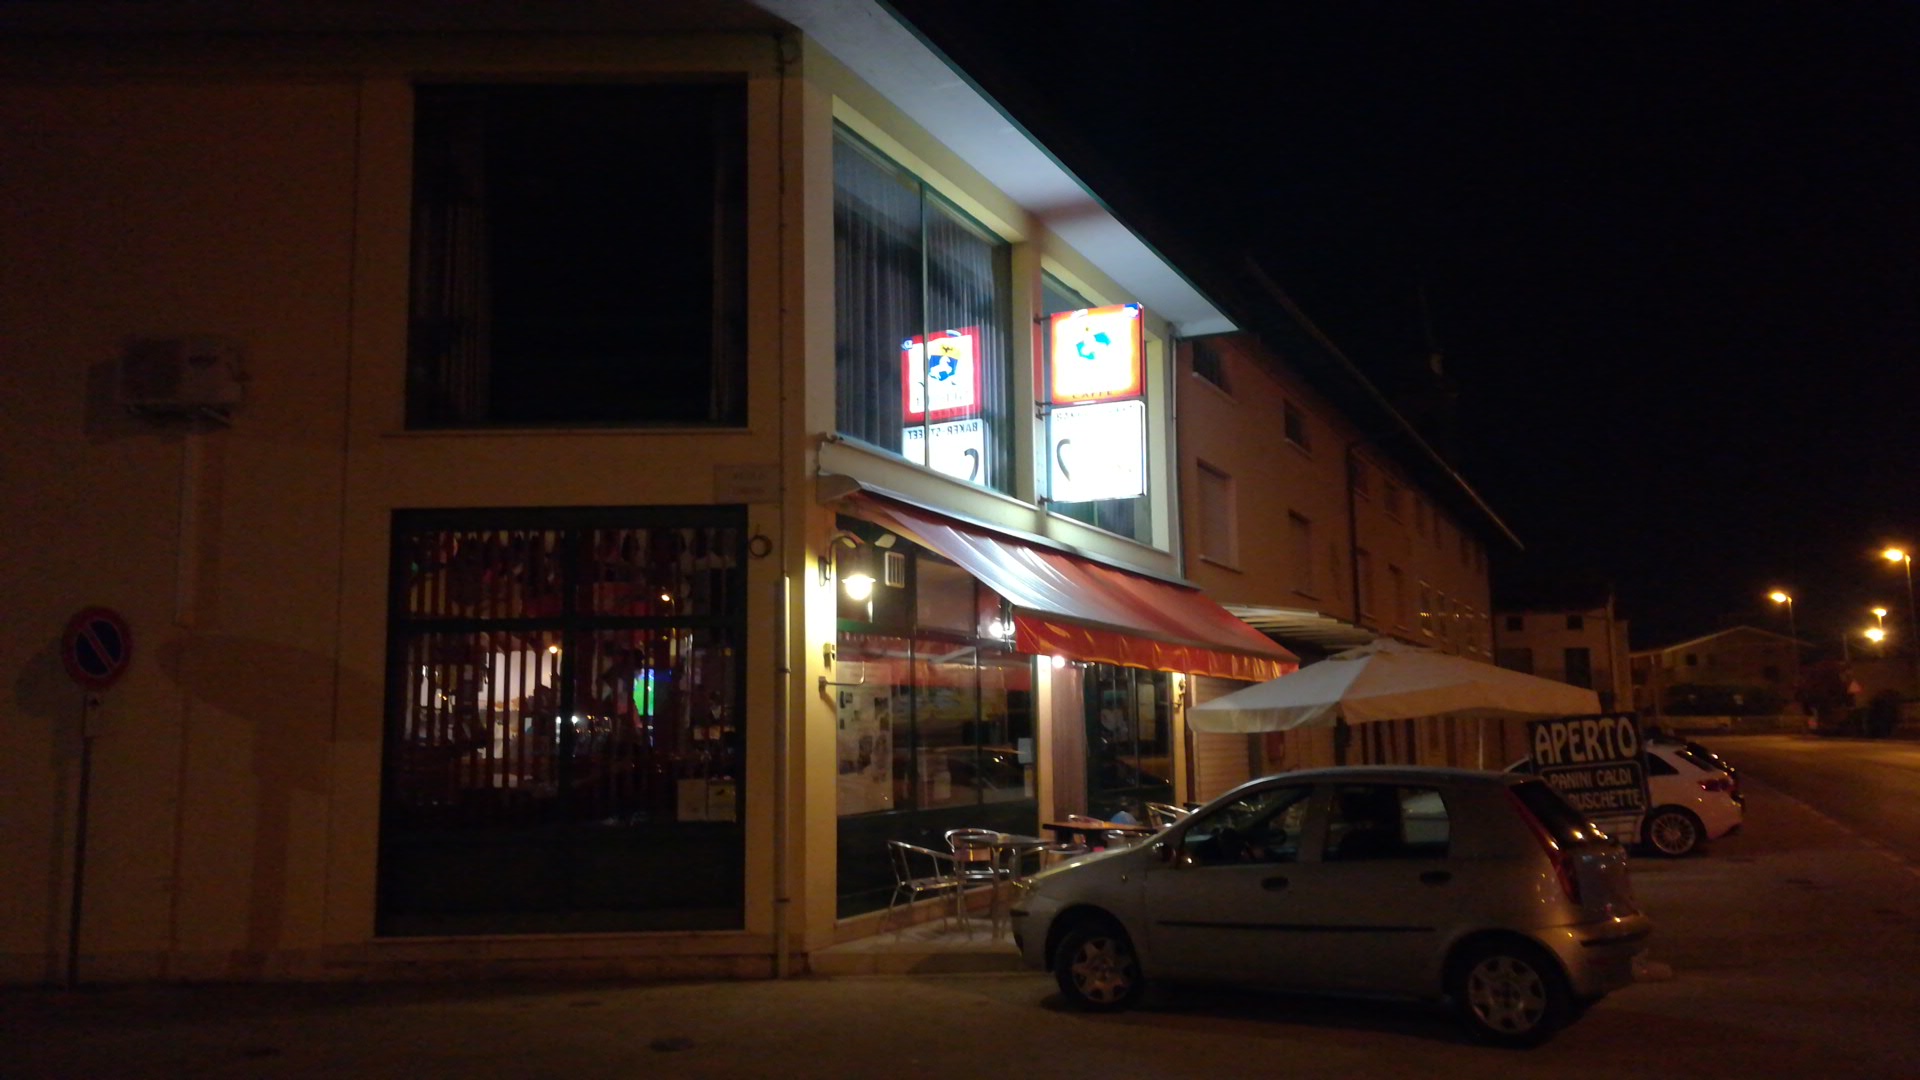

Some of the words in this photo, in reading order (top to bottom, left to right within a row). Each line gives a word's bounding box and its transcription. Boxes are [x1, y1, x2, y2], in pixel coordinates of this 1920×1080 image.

[1535, 717, 1637, 765] APERTO
[1551, 771, 1593, 790] PANINI
[1596, 768, 1632, 787] CALDI
